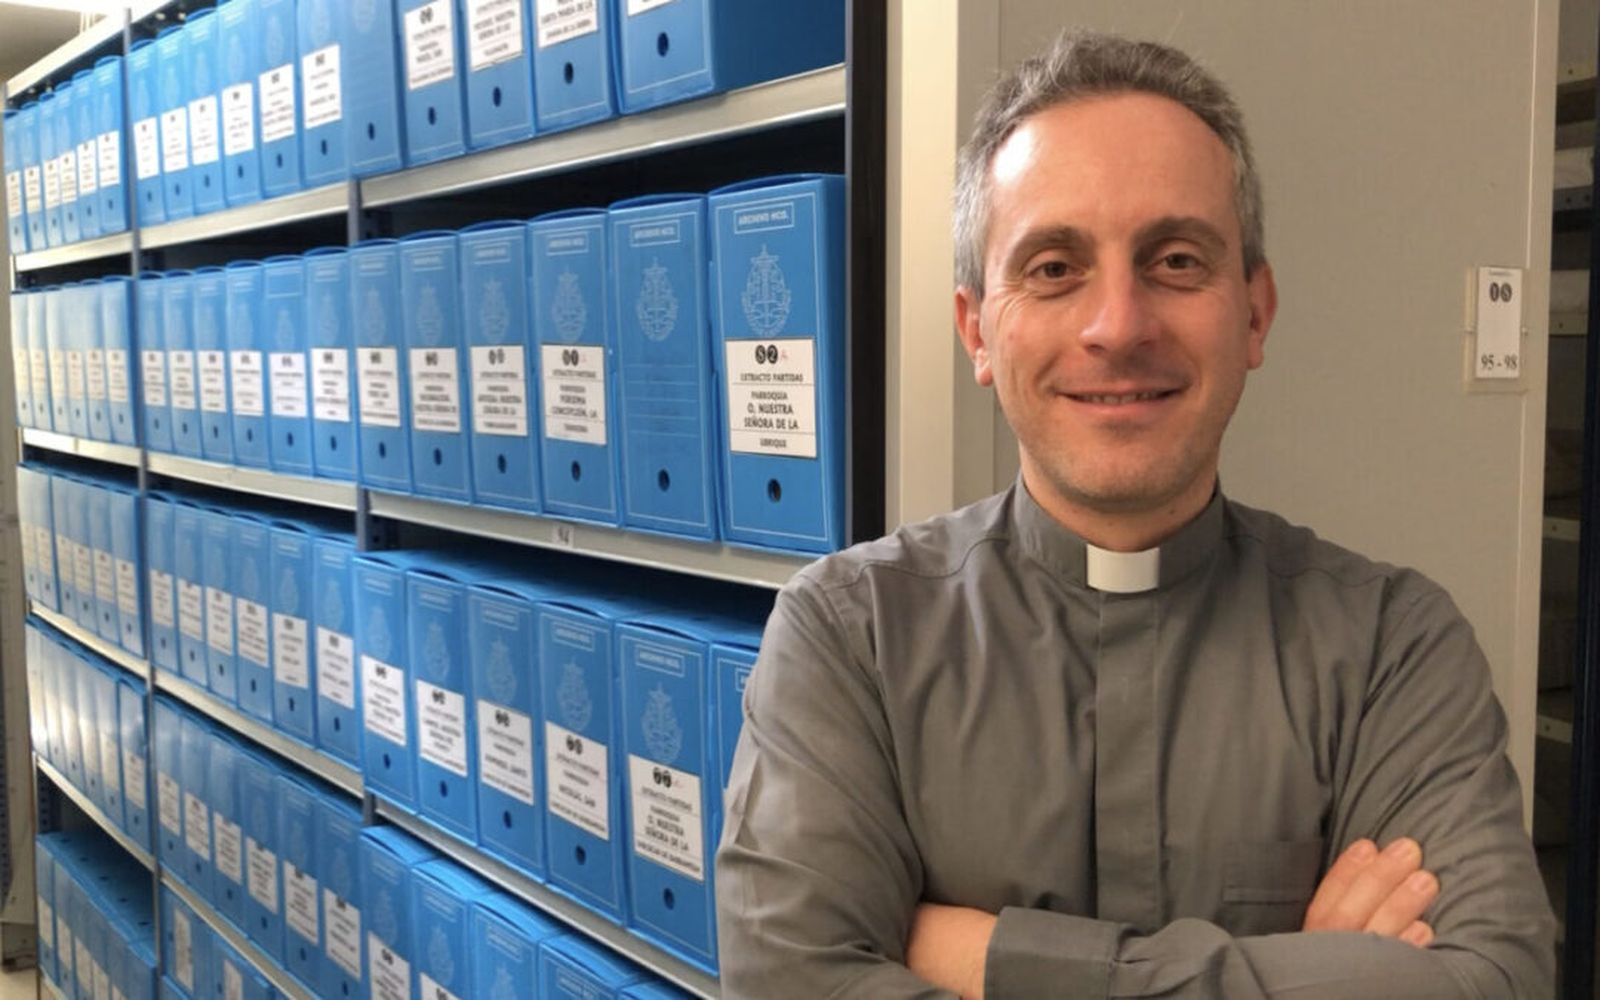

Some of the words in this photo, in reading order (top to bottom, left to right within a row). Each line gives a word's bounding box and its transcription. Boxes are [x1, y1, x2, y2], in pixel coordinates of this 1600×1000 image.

[1481, 354, 1494, 370] 95
[1504, 354, 1518, 370] 98
[740, 373, 771, 381] EXTRACTO
[773, 374, 803, 382] PARTIDAS
[751, 391, 788, 400] PARROQUIA
[758, 404, 793, 415] NUESTRA
[744, 416, 773, 428] SEÑORA
[776, 419, 786, 429] DE
[788, 420, 798, 430] LA
[760, 438, 786, 448] UBRIQUE
